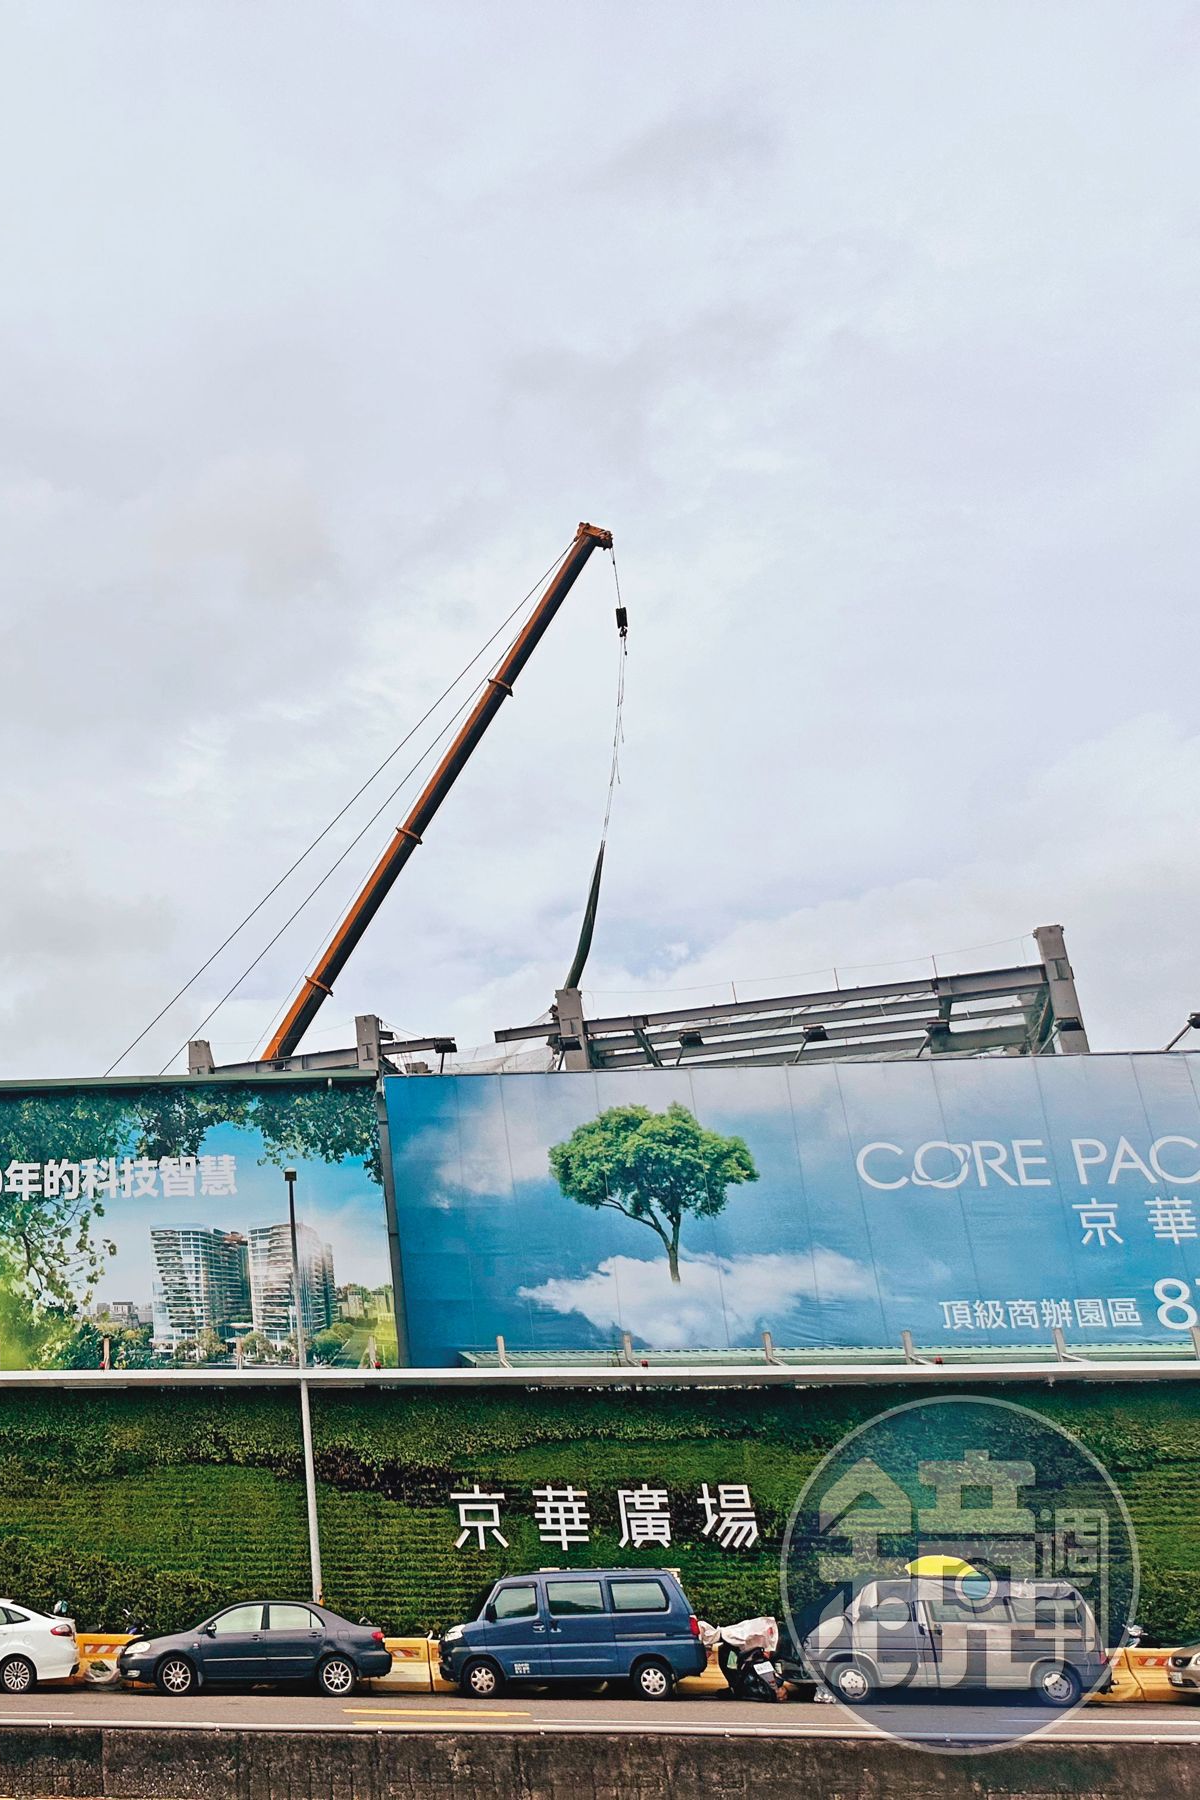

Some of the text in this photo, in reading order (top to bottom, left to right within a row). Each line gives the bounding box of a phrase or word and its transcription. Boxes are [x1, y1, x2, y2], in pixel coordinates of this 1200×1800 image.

[856, 1136, 1200, 1190] CORE PAC
[1071, 1196, 1199, 1246] 京華
[939, 1277, 1200, 1330] 頂級商辦園區 8
[450, 1483, 759, 1551] 京華廣場
